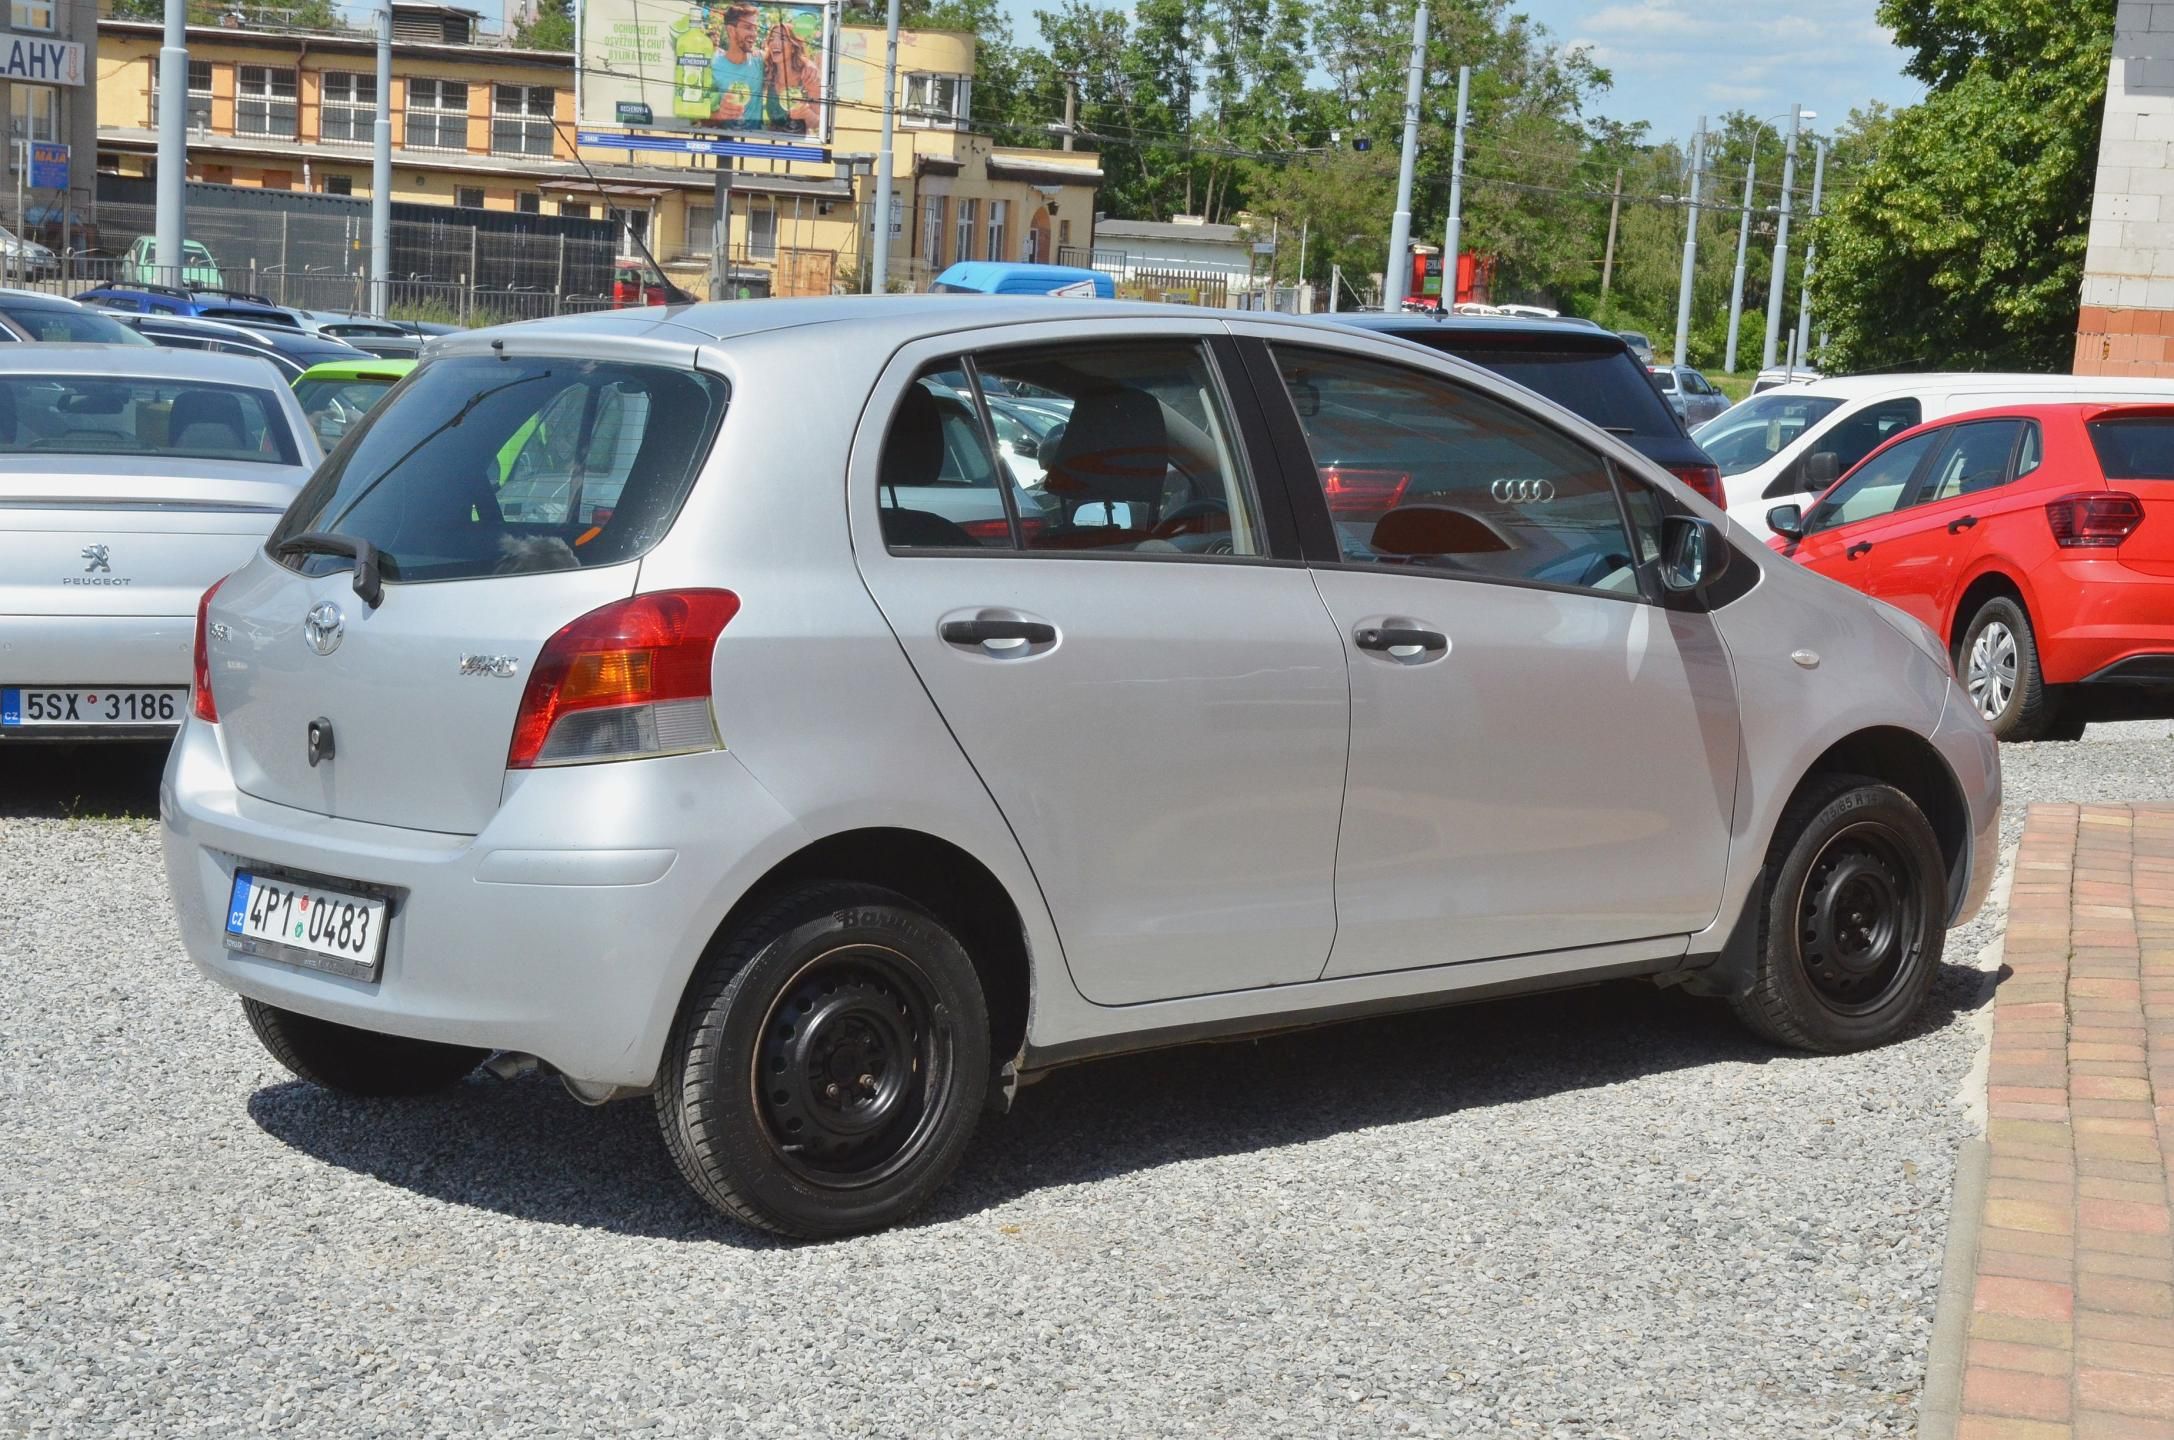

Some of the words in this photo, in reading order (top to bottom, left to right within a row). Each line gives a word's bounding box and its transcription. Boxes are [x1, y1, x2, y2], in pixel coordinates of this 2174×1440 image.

[63, 577, 131, 586] PEUGEOT
[28, 693, 80, 720] 5SX
[105, 693, 174, 720] 3186
[4, 711, 19, 721] CZ
[231, 911, 244, 926] CZ
[250, 885, 294, 937] 4P1
[308, 897, 370, 953] 0483
